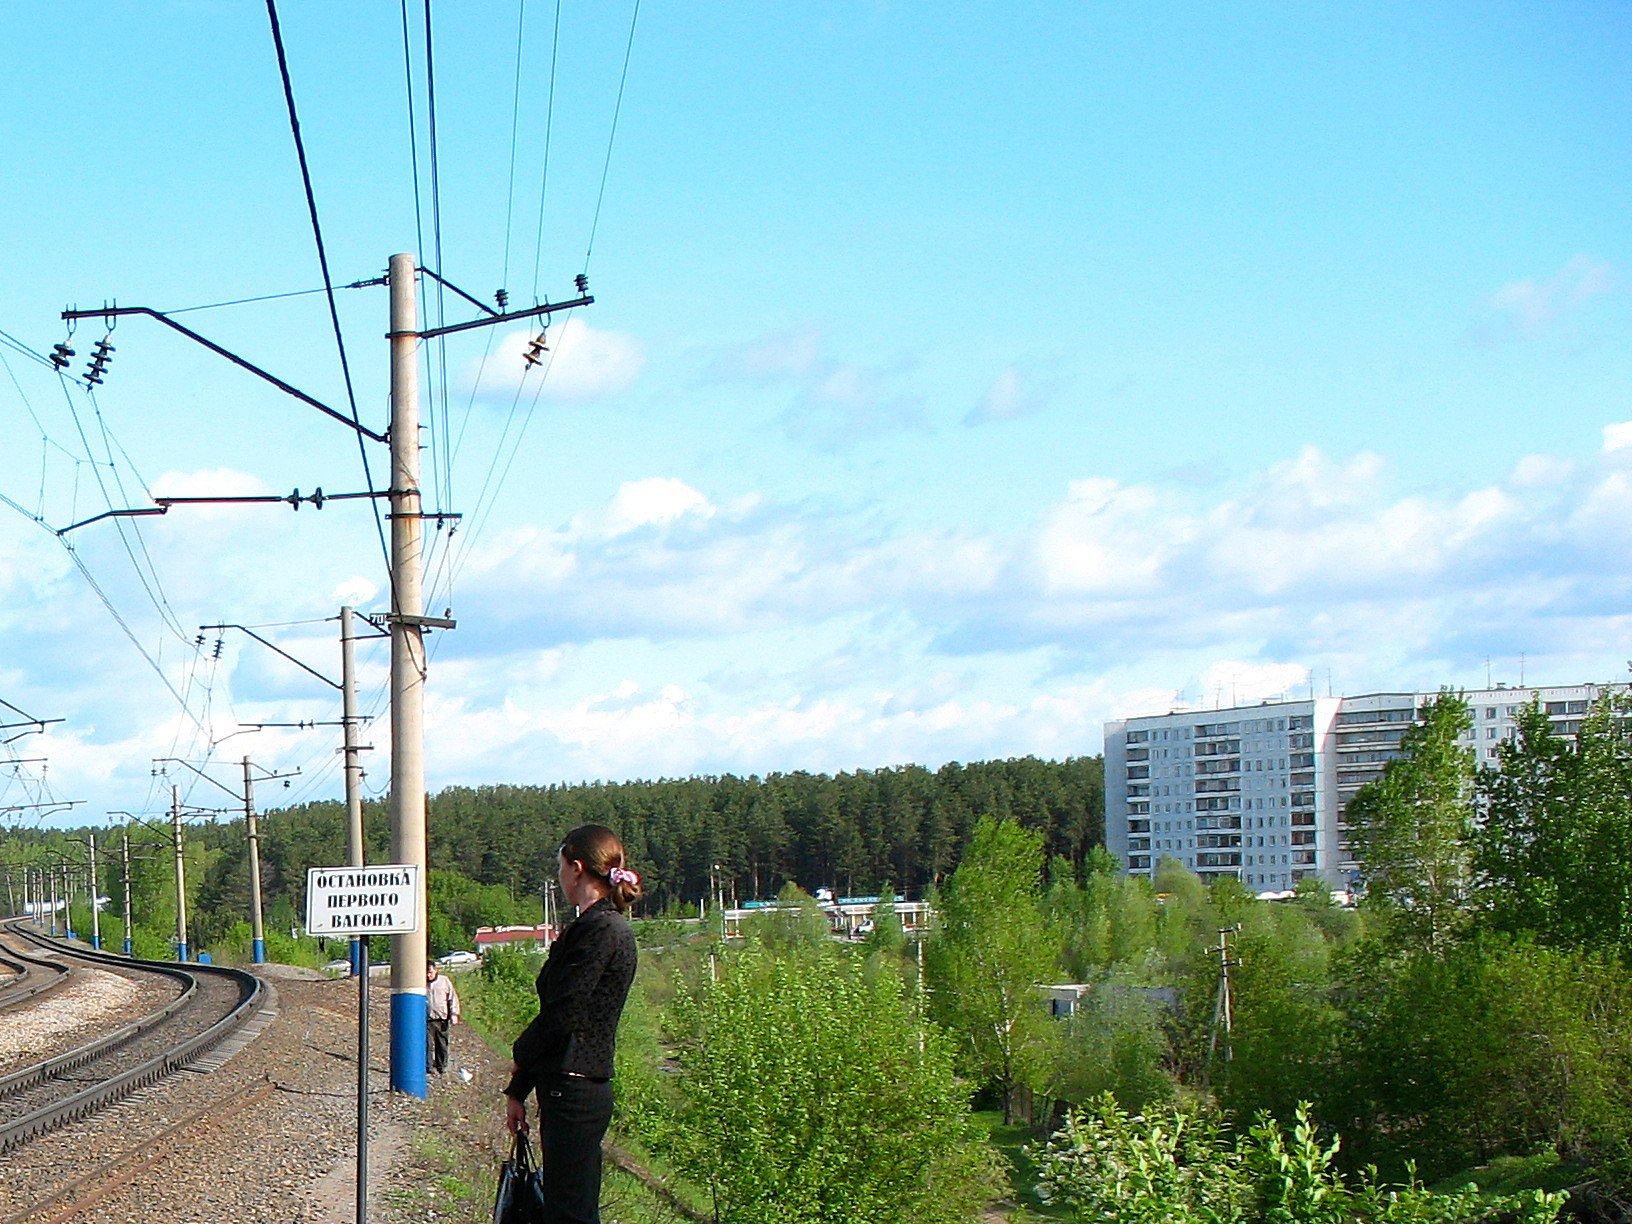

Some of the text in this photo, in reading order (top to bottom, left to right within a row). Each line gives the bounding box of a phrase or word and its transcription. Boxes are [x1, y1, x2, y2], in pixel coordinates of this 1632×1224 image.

[317, 872, 411, 888] ОСТАНОВКА
[327, 893, 399, 908] ПЕРВОГО
[331, 913, 393, 928] ВАГОНА
